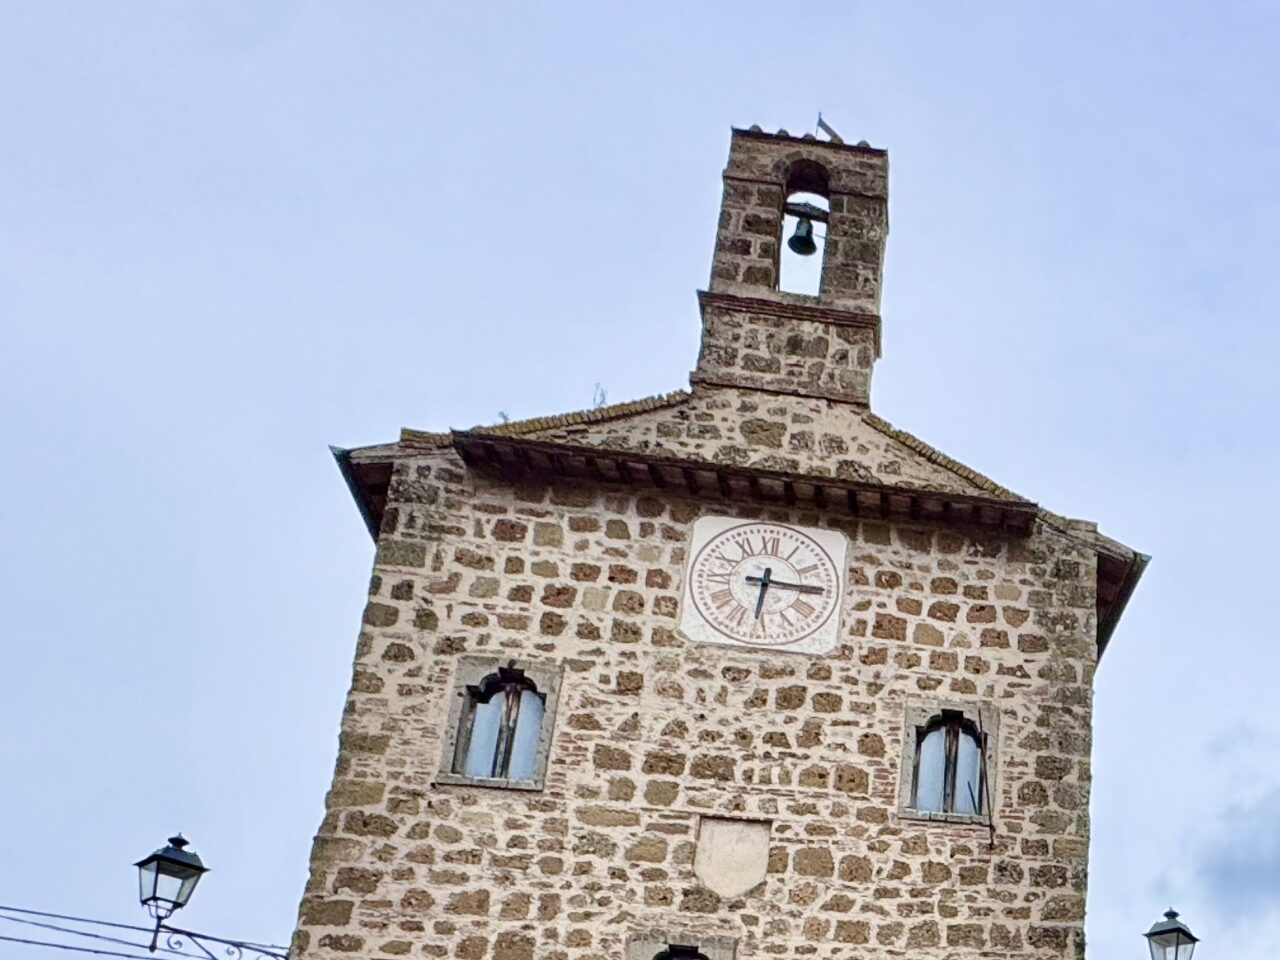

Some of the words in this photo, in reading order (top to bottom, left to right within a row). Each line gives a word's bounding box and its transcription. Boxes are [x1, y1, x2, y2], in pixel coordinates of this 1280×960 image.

[735, 537, 755, 560] XI
[759, 535, 780, 557] XII
[714, 551, 739, 569] X
